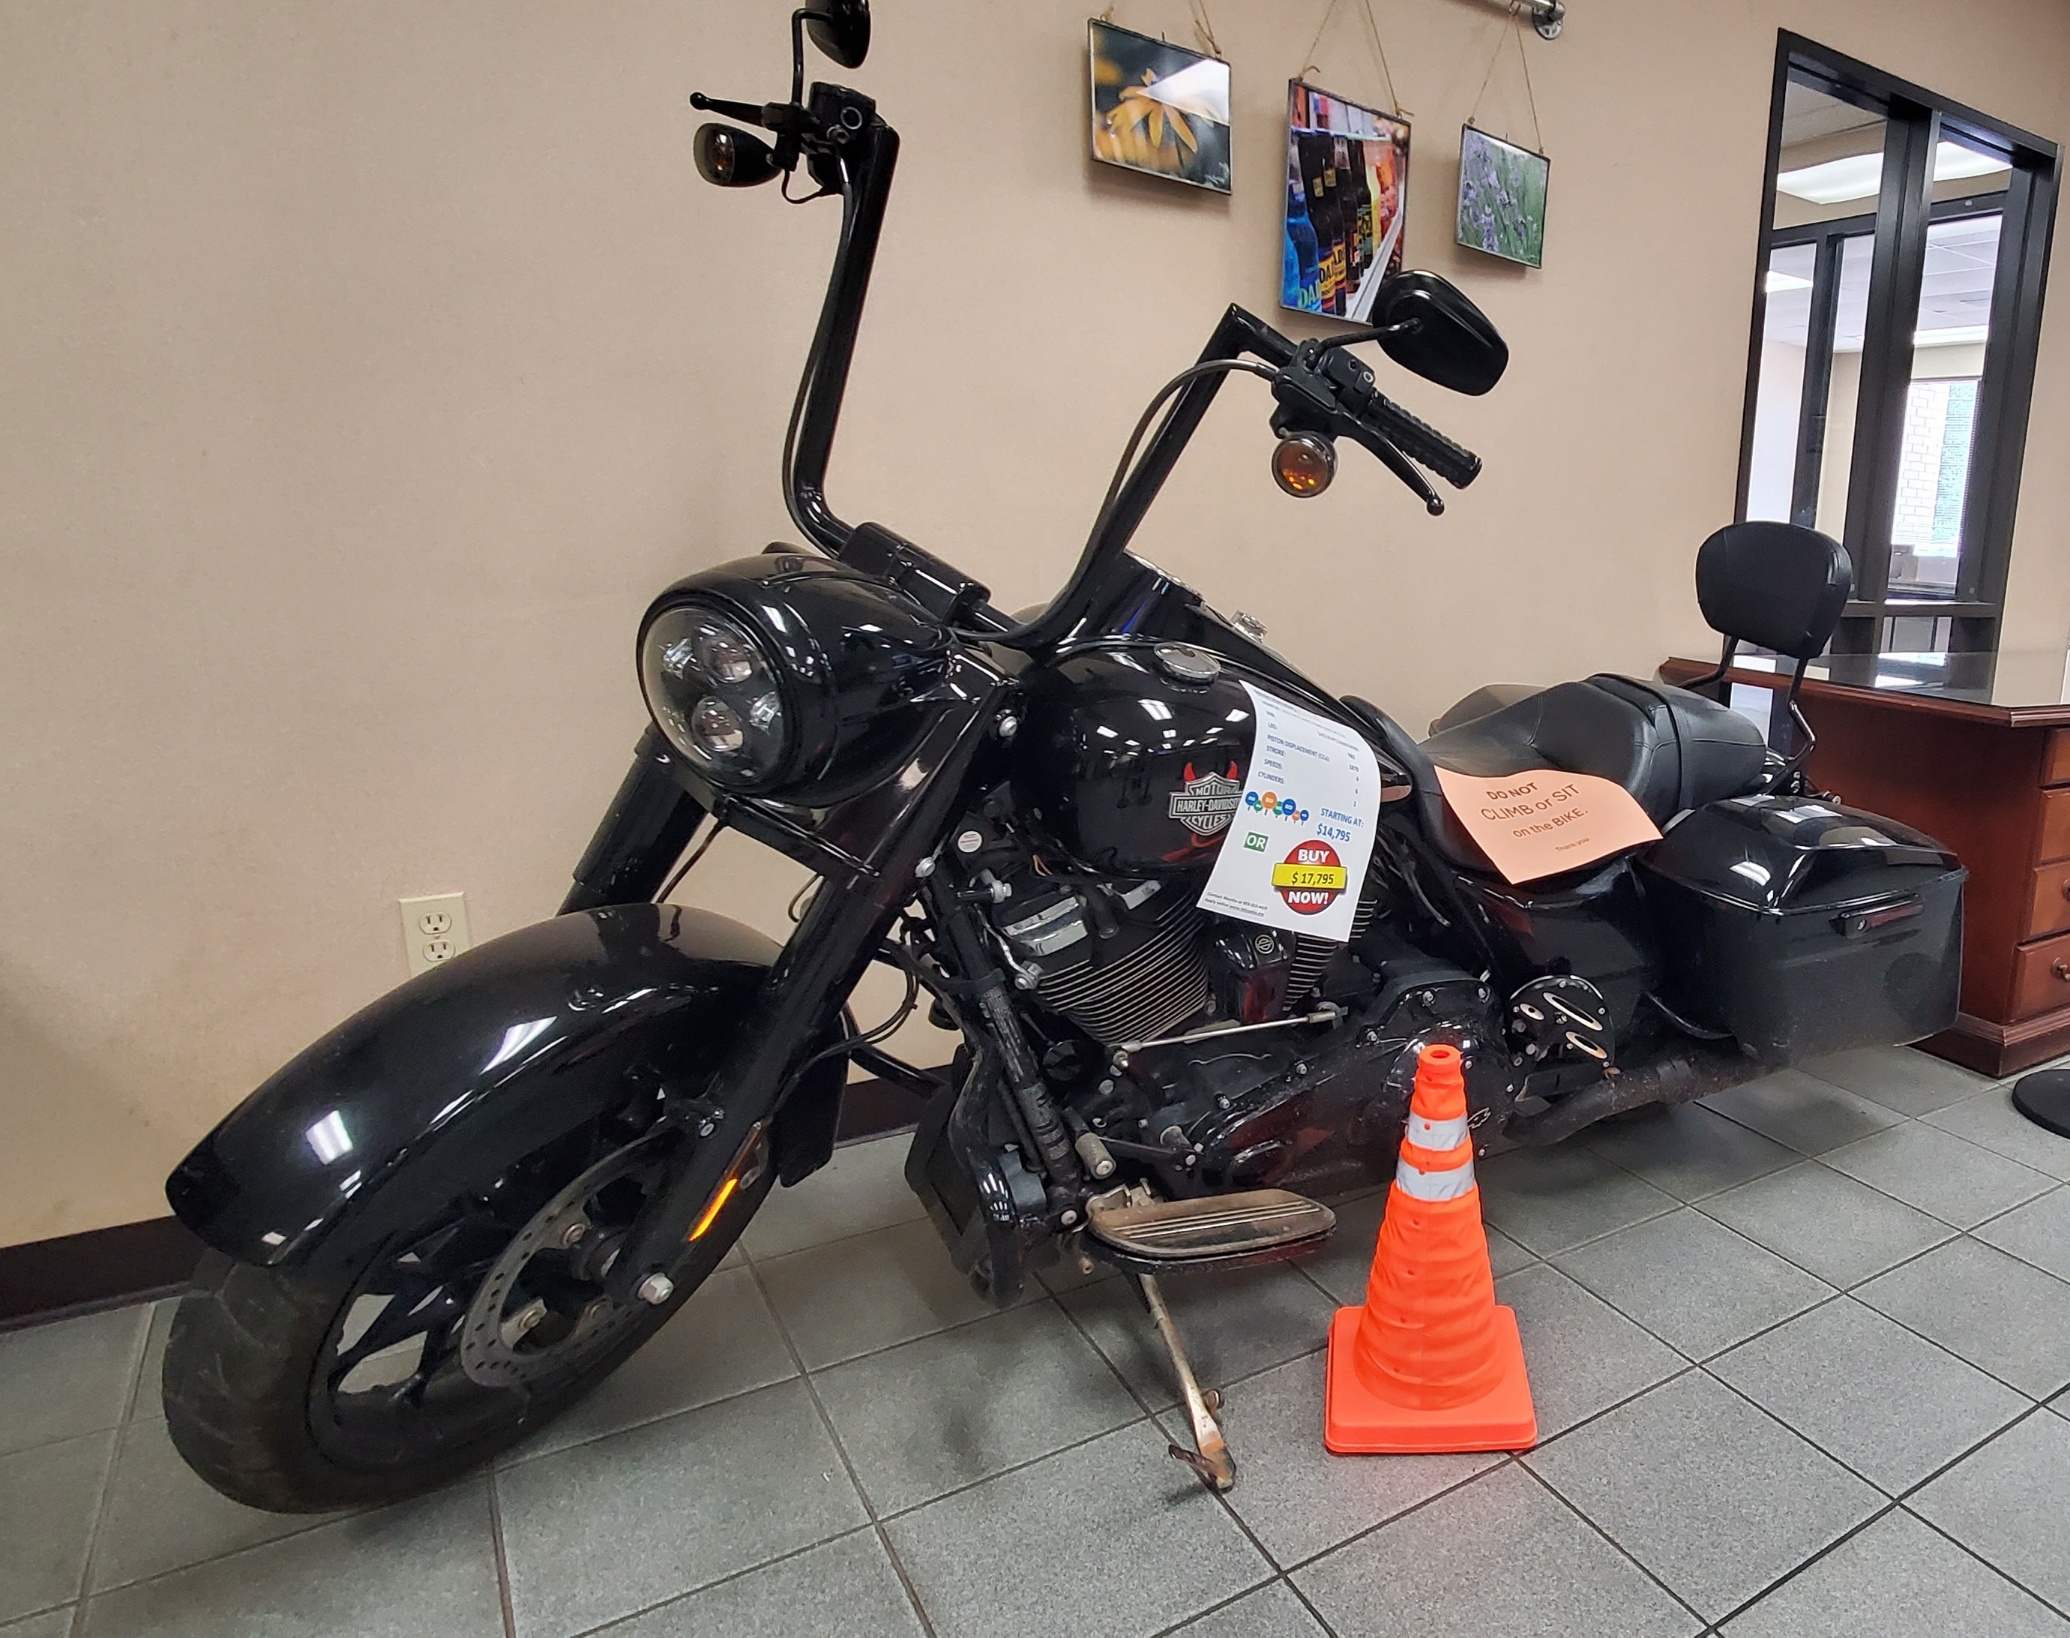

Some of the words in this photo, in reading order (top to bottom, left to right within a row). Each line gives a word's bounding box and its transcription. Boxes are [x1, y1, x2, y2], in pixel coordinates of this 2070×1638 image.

[1486, 790, 1509, 800] DO
[1508, 782, 1538, 798] NOT
[1481, 804, 1534, 820] CLIMB
[1535, 798, 1553, 810] or
[1552, 783, 1580, 802] SIT
[1192, 814, 1227, 830] CYCLES
[1320, 807, 1353, 825] STARTING
[1352, 817, 1365, 828] AT:
[1512, 828, 1532, 838] on
[1529, 823, 1554, 834] the
[1551, 807, 1589, 827] BIKE.
[1316, 823, 1351, 842] $14,795
[1246, 834, 1266, 849] OR
[1297, 848, 1330, 863] BUY
[1291, 871, 1299, 886] $
[1301, 872, 1335, 886] 17,795
[1287, 891, 1329, 905] NOW!
